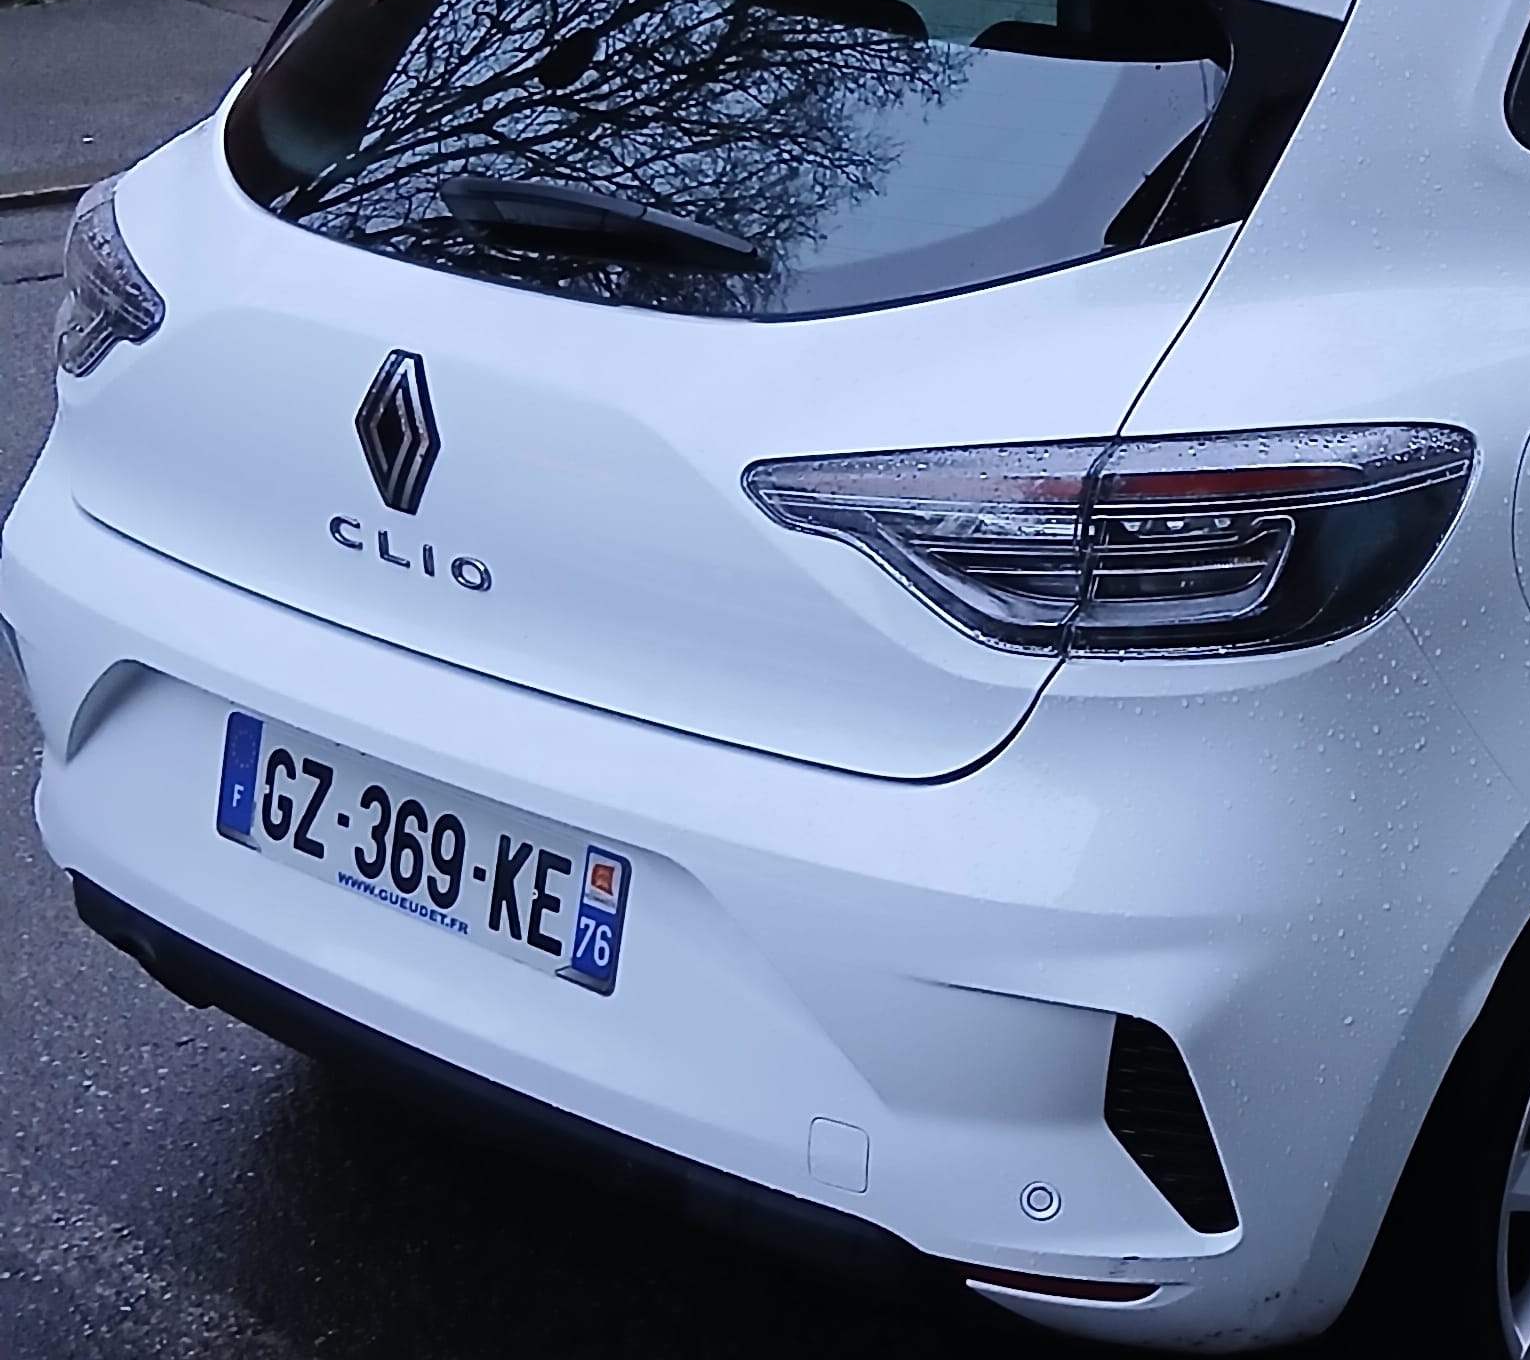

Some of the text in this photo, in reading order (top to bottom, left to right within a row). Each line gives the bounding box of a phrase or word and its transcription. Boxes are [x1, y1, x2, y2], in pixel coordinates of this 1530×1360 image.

[329, 516, 492, 592] CLIO
[232, 784, 244, 808] F
[262, 748, 572, 957] GZ-369-KE
[338, 871, 469, 935] WWW.GUEUDET.FR
[576, 916, 613, 967] 76
